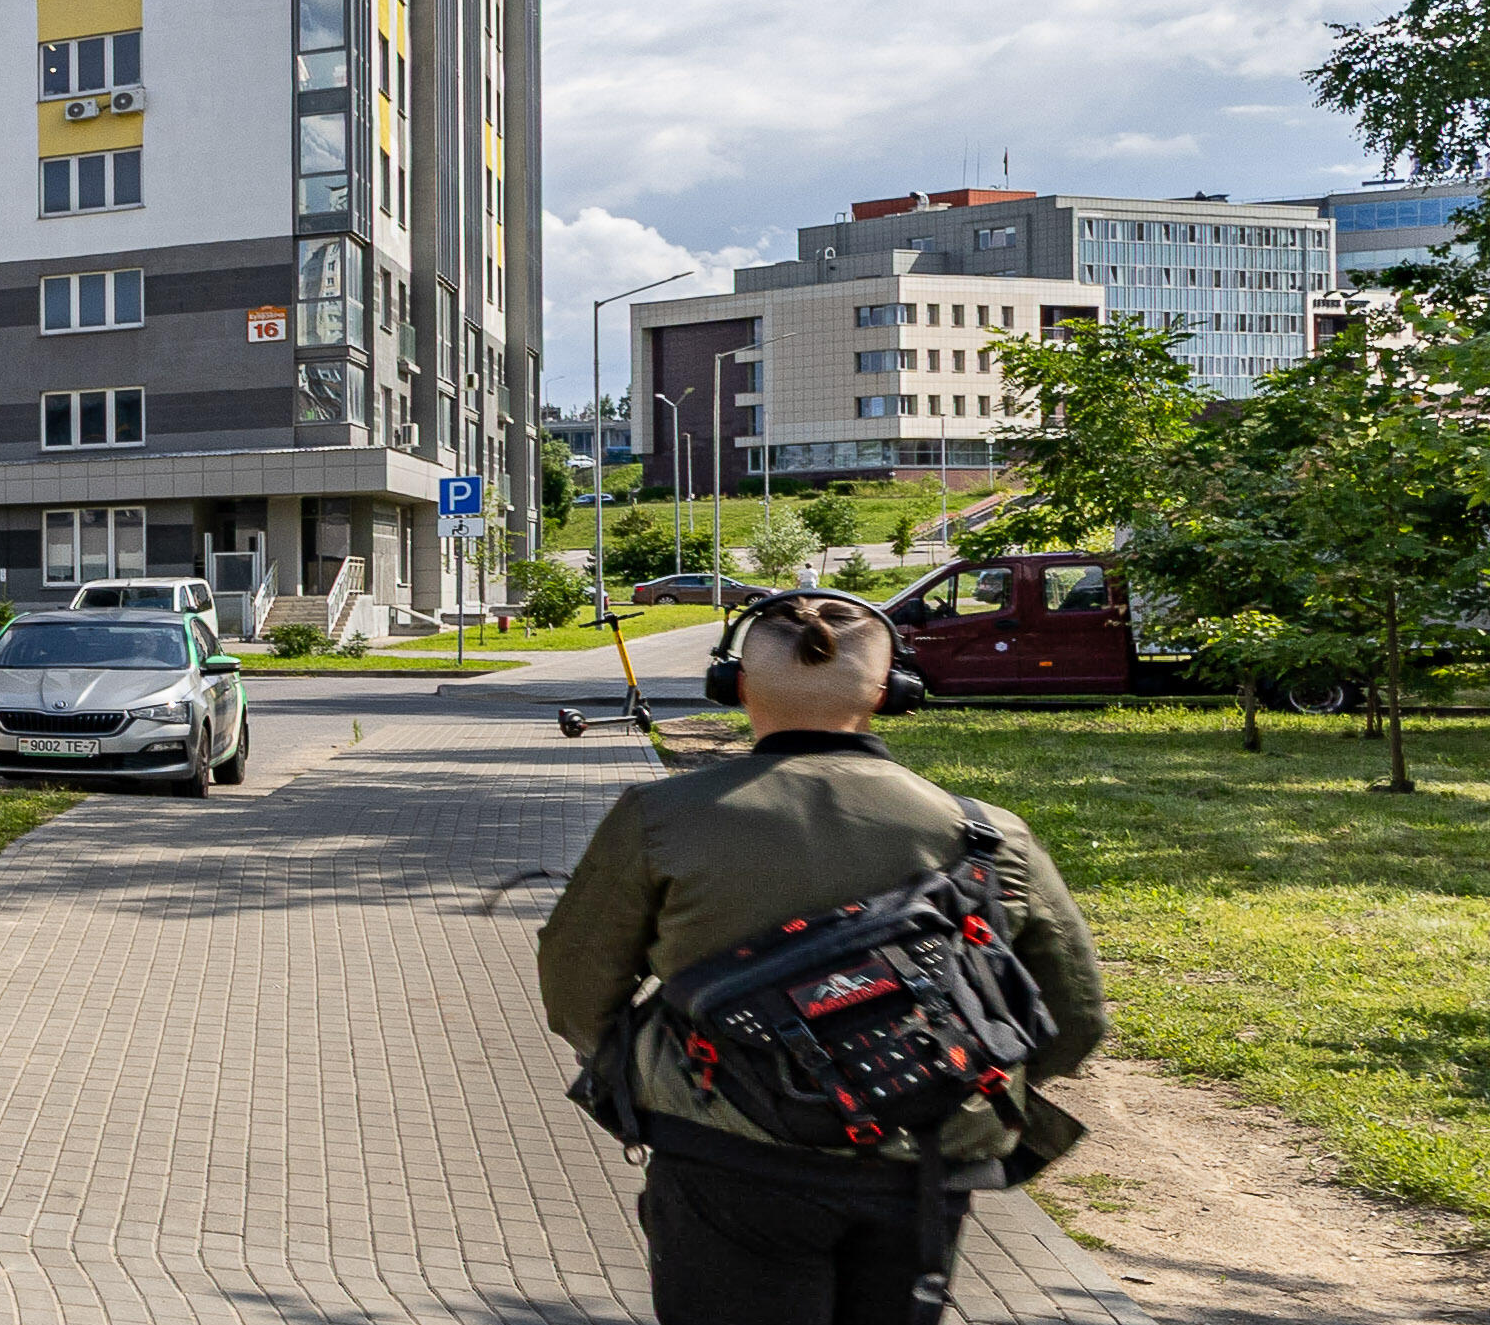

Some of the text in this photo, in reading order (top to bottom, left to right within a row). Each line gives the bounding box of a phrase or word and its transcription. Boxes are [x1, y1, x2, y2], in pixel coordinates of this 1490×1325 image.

[254, 322, 279, 338] 16
[449, 481, 472, 511] P
[30, 740, 97, 753] 9002 TE-7
